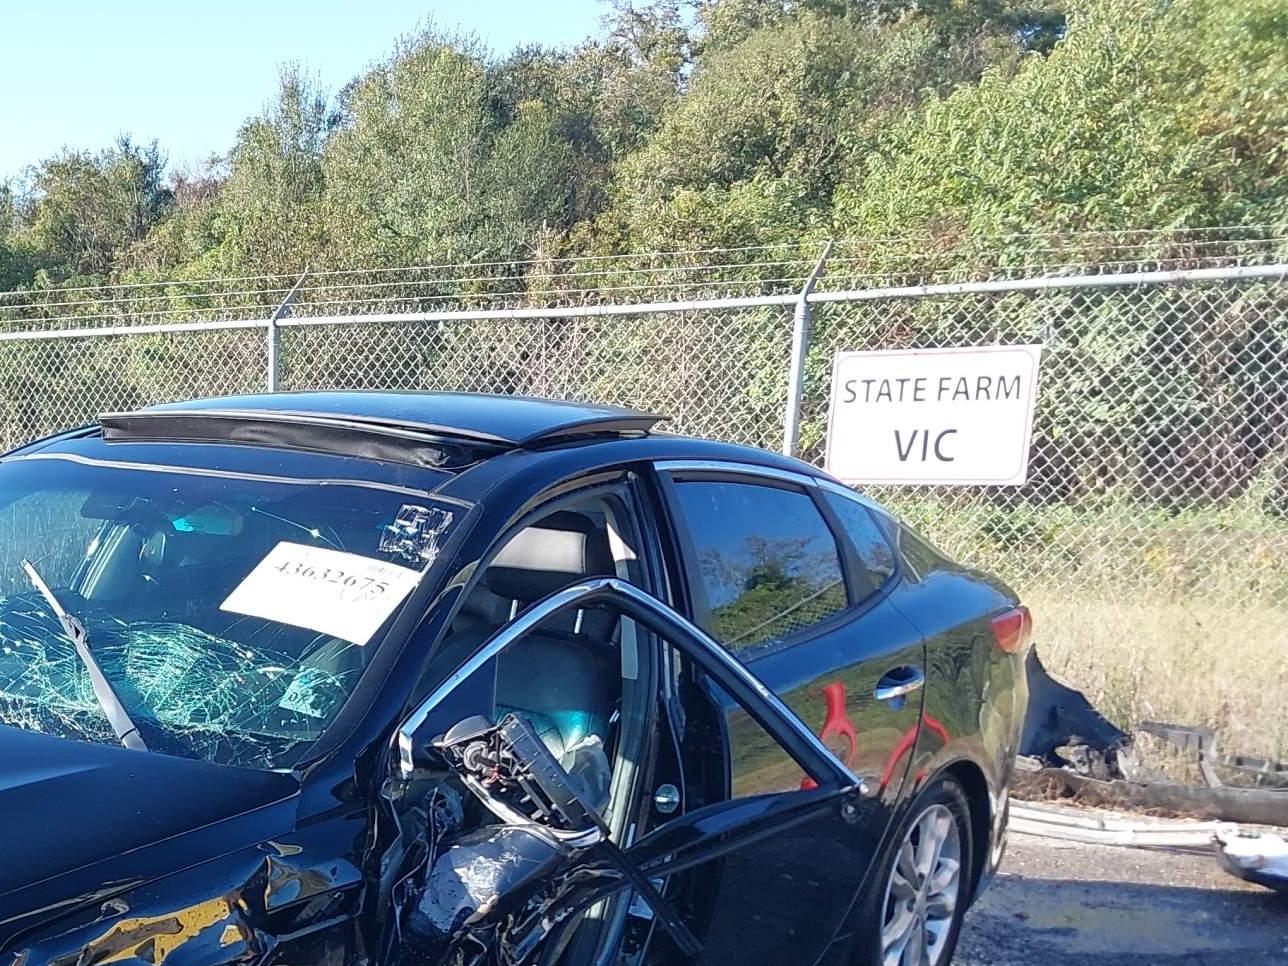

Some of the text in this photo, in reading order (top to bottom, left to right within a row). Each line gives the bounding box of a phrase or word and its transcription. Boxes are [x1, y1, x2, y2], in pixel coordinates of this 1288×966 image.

[843, 375, 1022, 403] STATE FARM
[894, 429, 958, 462] VIC
[274, 560, 390, 595] 43632675
